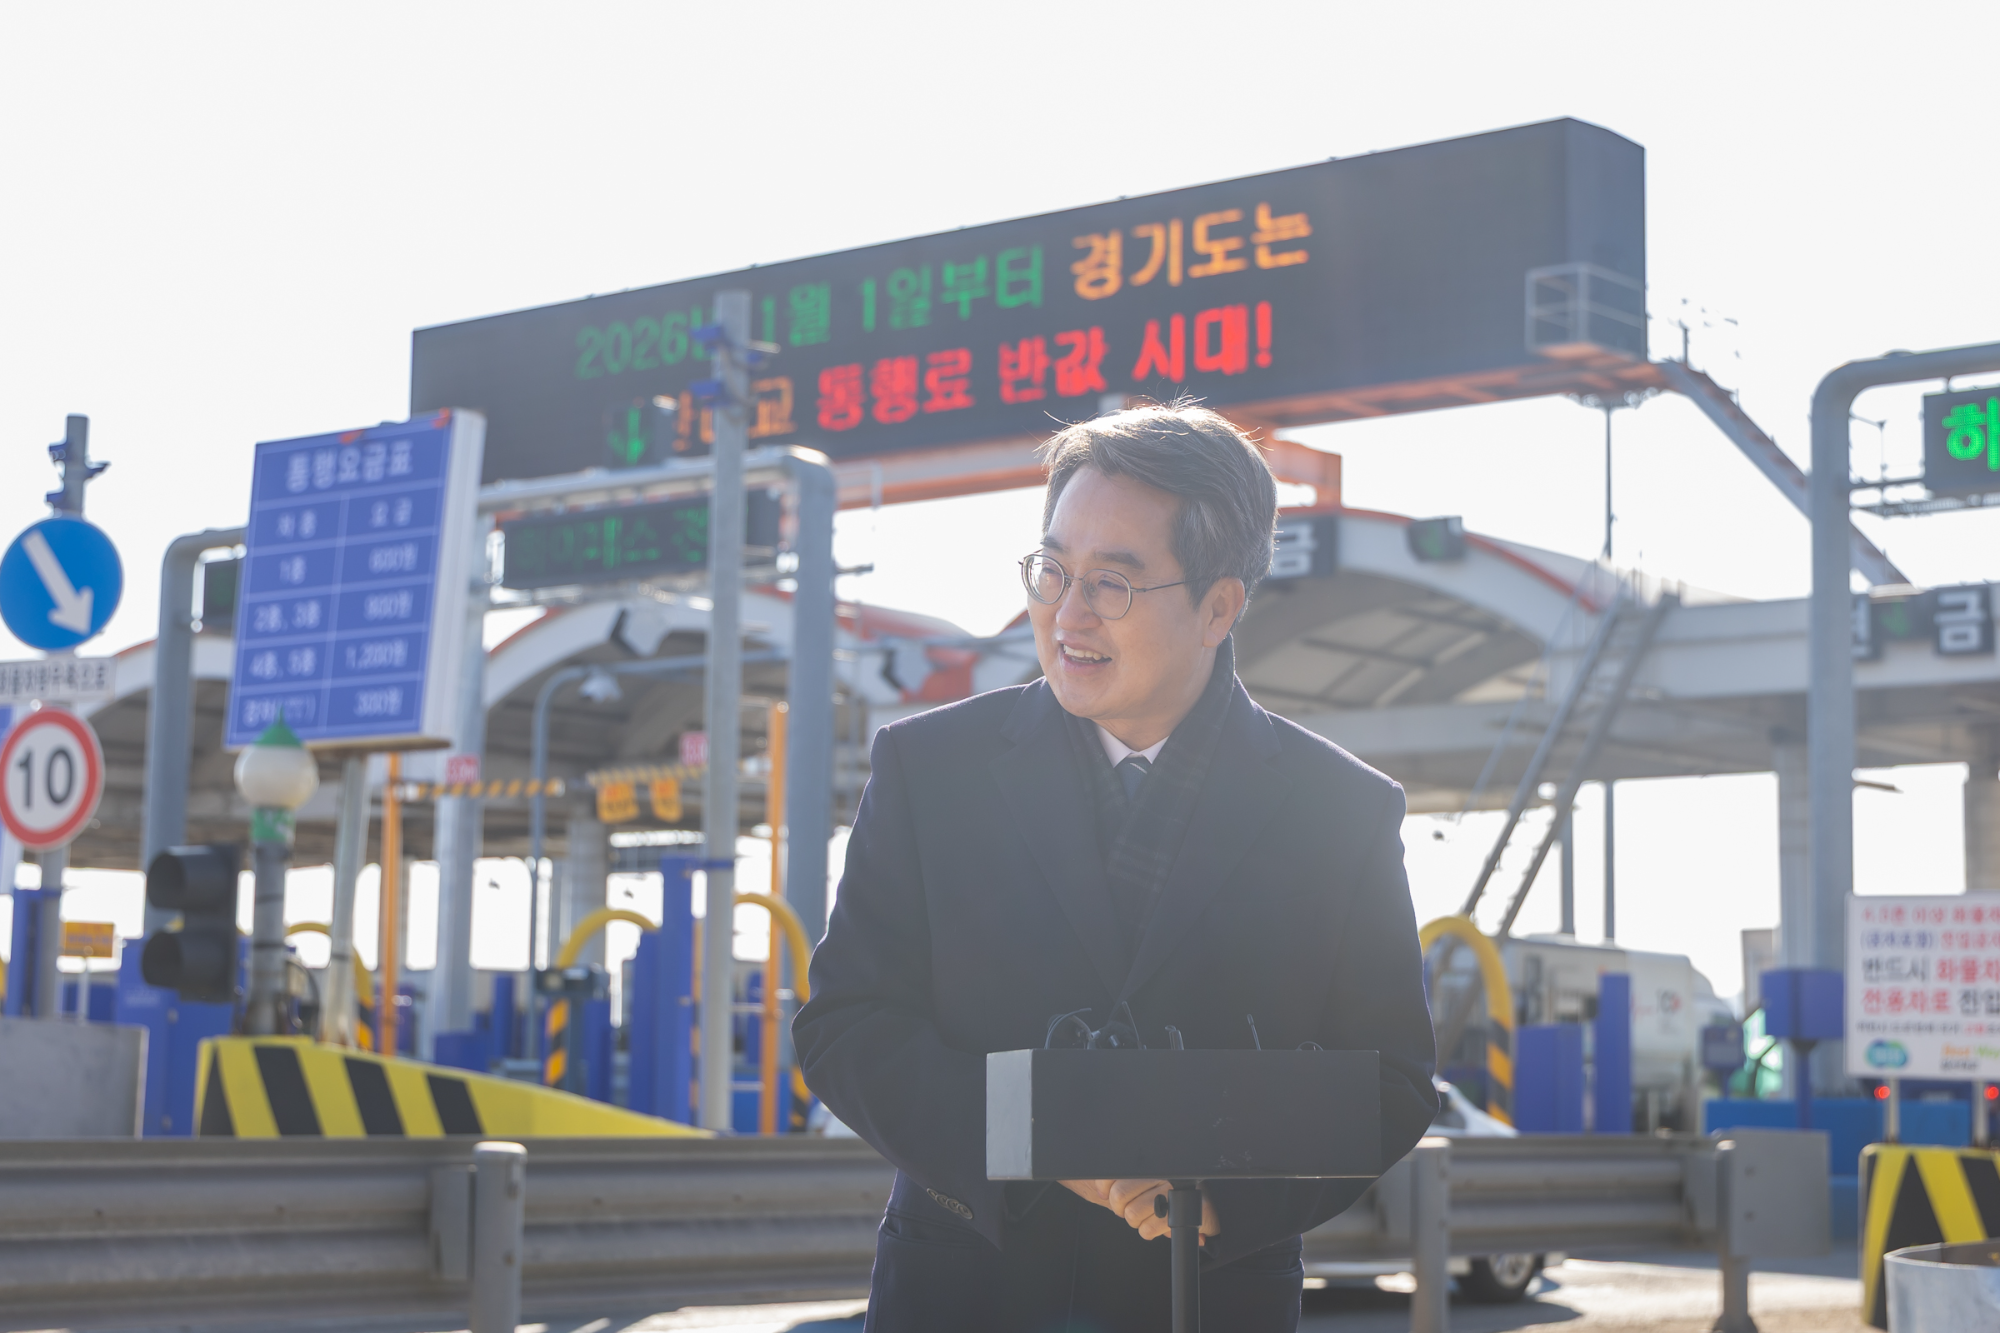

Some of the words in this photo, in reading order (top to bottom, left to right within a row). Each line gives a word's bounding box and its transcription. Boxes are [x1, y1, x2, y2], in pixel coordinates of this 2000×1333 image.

[861, 245, 1044, 333] 1일부터
[1070, 202, 1312, 301] 경기도는
[816, 347, 975, 432] 통행료
[999, 326, 1108, 404] 반값
[1132, 301, 1273, 382] 시대!
[16, 745, 75, 811] 10
[1861, 954, 1931, 983] 반드시
